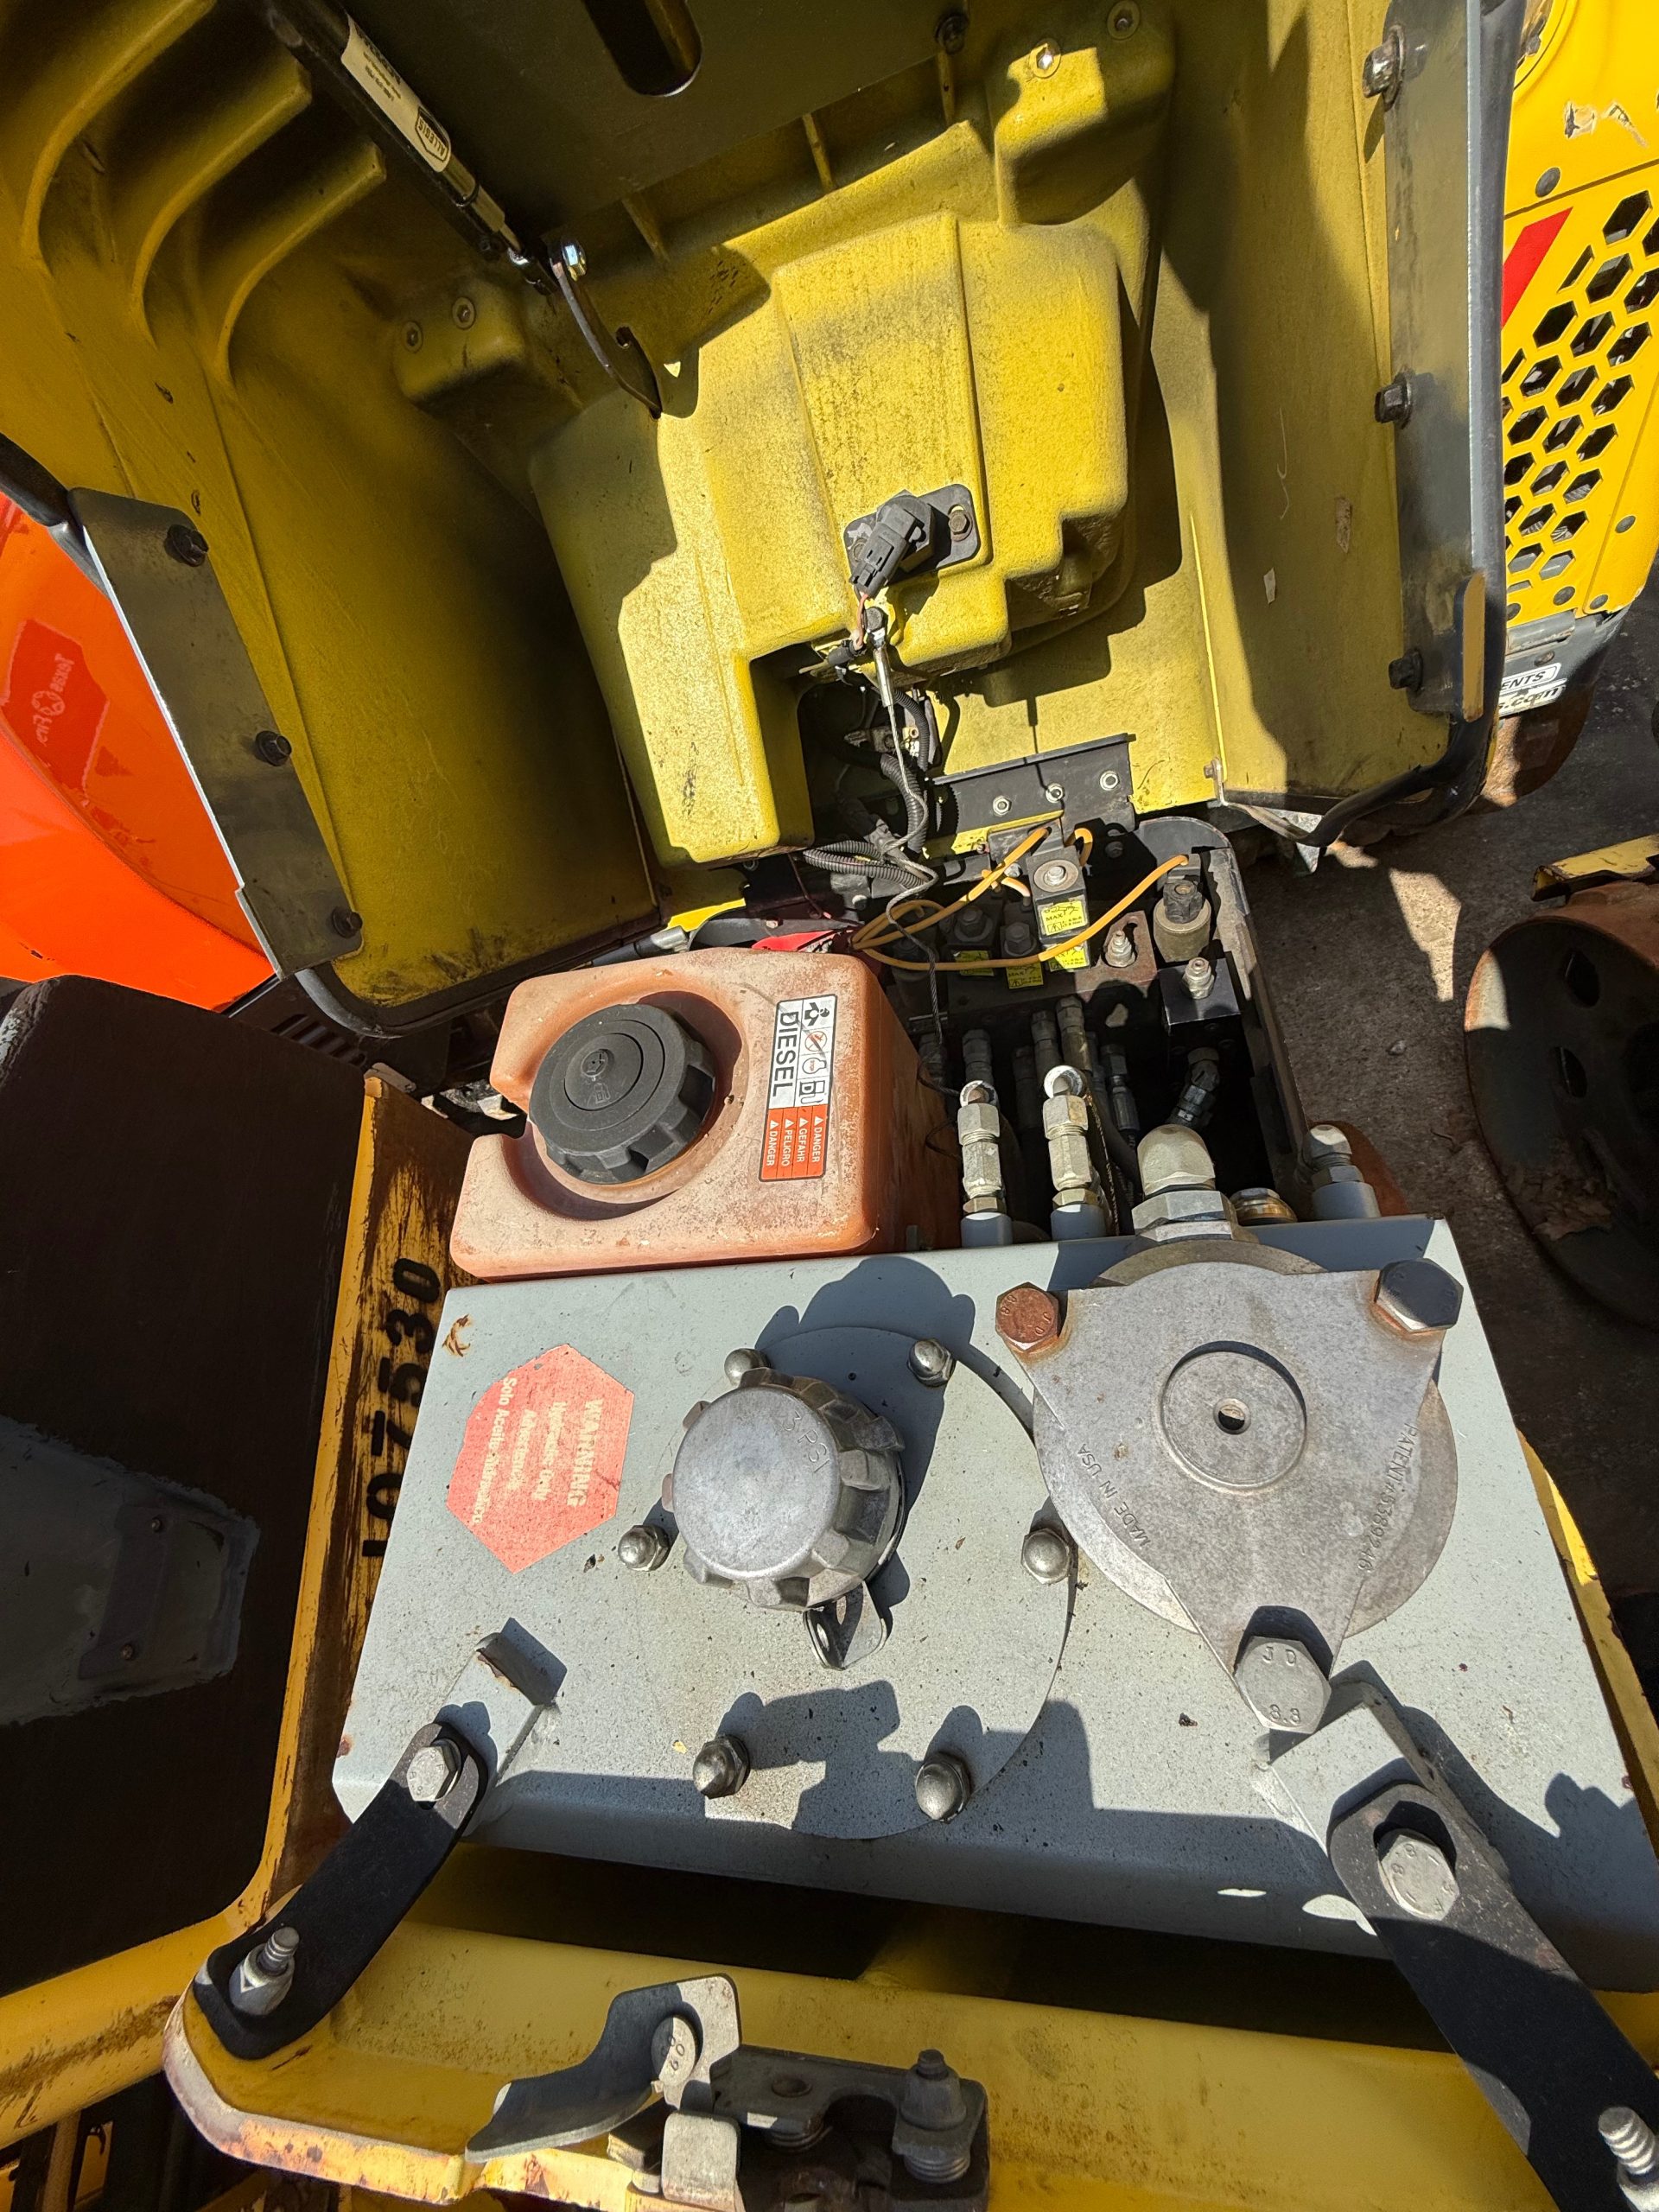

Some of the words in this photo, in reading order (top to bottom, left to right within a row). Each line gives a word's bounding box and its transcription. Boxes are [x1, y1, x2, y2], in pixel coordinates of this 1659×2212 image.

[418, 119, 446, 156] ALLEGIS
[772, 1011, 800, 1097] DIESEL
[766, 1130, 779, 1166] DANGER
[781, 1128, 793, 1166] PELIGRO
[796, 1128, 808, 1163] GEFAHR
[811, 1127, 823, 1163] DANGER
[498, 1377, 518, 1406] Solo
[488, 1408, 510, 1451] Aceite
[785, 1410, 802, 1433] 3
[798, 1427, 831, 1473] PSI
[566, 1398, 603, 1508] WARNING
[1077, 1444, 1103, 1477] USA
[1099, 1480, 1118, 1499] IN
[1114, 1501, 1151, 1548] MADE
